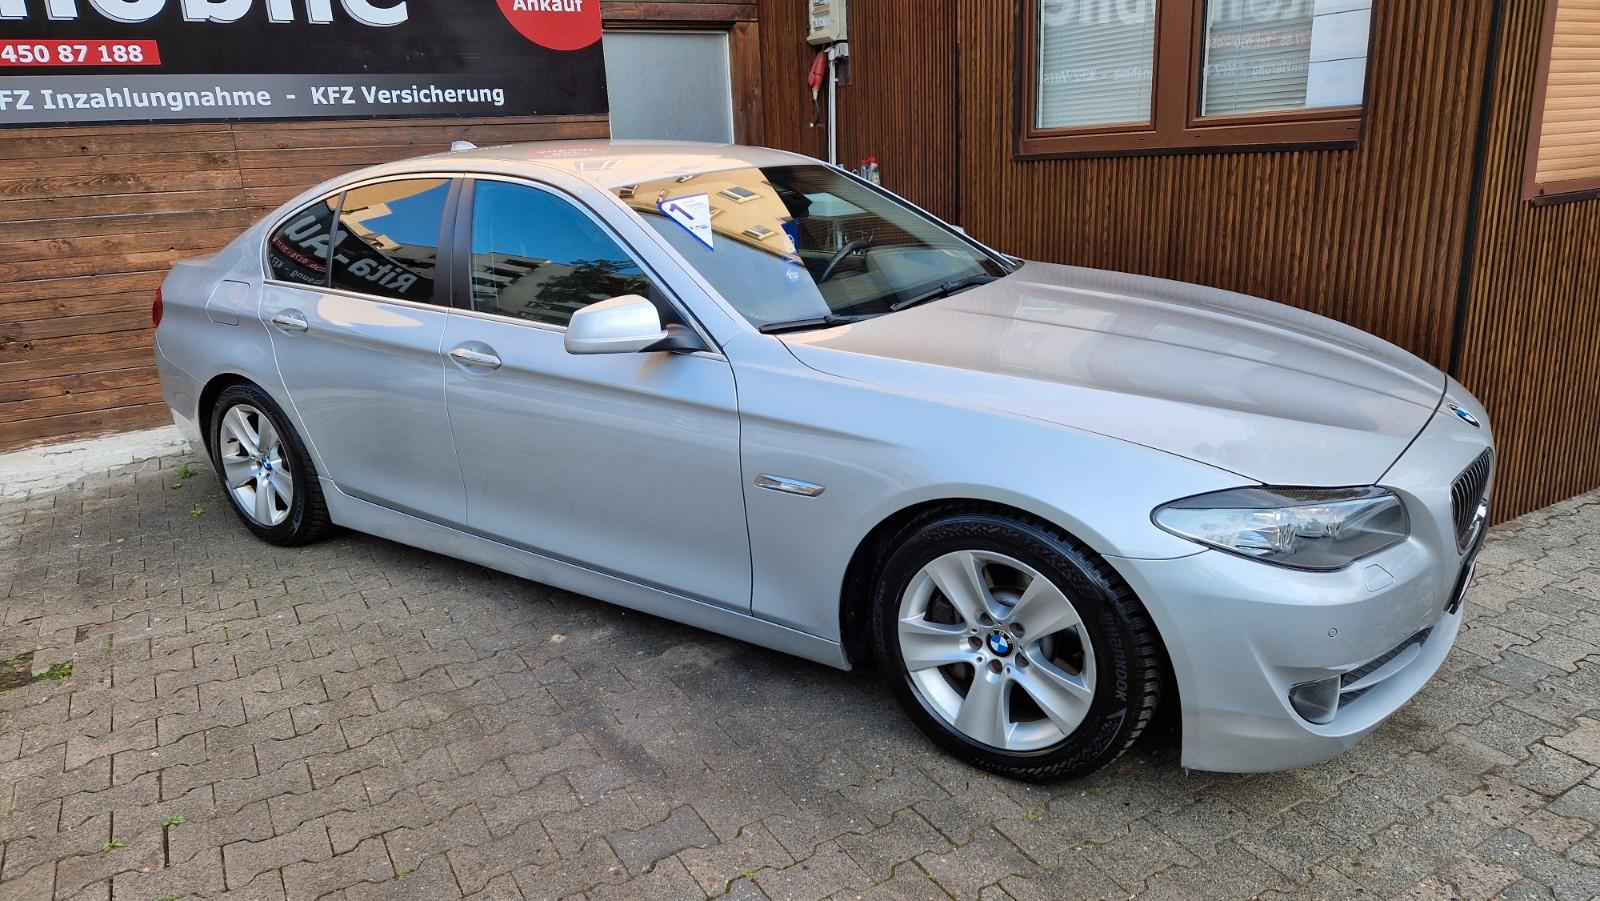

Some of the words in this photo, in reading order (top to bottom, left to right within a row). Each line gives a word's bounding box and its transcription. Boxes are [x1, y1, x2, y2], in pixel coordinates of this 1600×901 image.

[513, 0, 582, 12] Ankauf
[1, 45, 50, 63] 450
[57, 45, 88, 63] 87
[98, 45, 144, 63] 188
[40, 87, 272, 112] Inzahlungnahme
[311, 87, 356, 105] KFZ
[361, 85, 505, 106] Versicherung
[669, 203, 695, 221] 1
